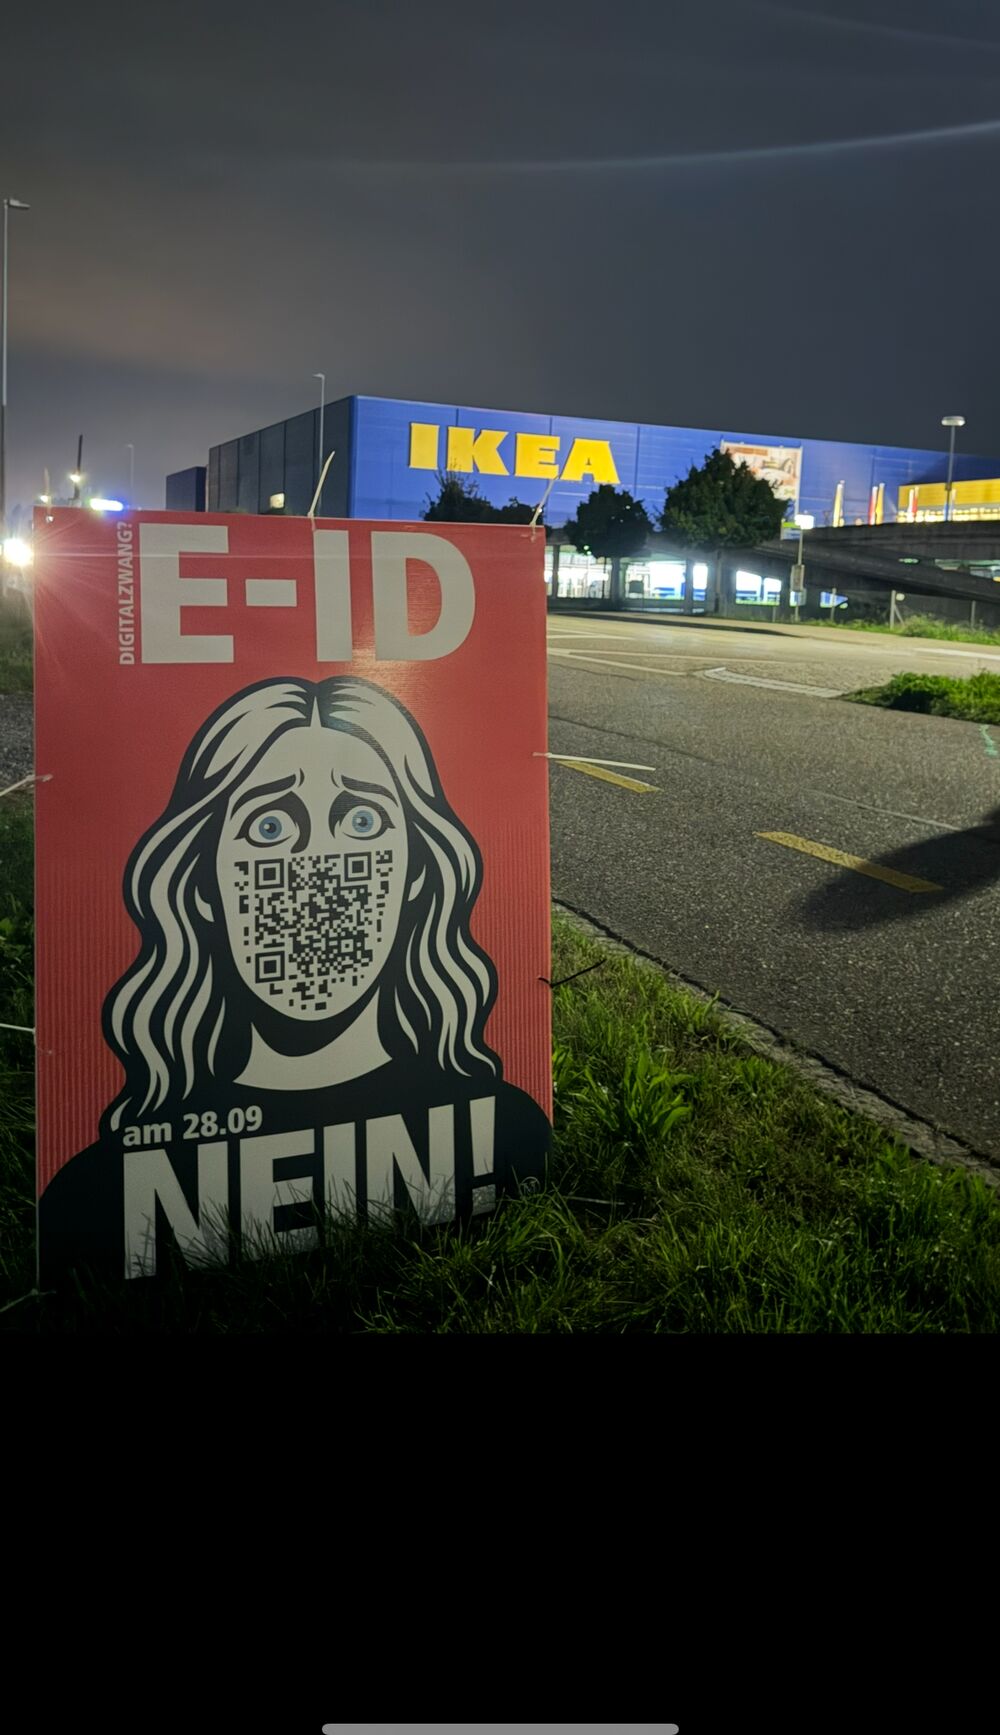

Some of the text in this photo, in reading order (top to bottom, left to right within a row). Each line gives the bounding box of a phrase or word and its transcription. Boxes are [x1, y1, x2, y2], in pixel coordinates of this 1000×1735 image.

[409, 422, 620, 484] IKEA
[118, 521, 136, 665] DIGITALZWANG?
[139, 523, 476, 664] E-ID
[122, 1105, 263, 1146] am 28.09
[123, 1096, 496, 1280] NEIN!
